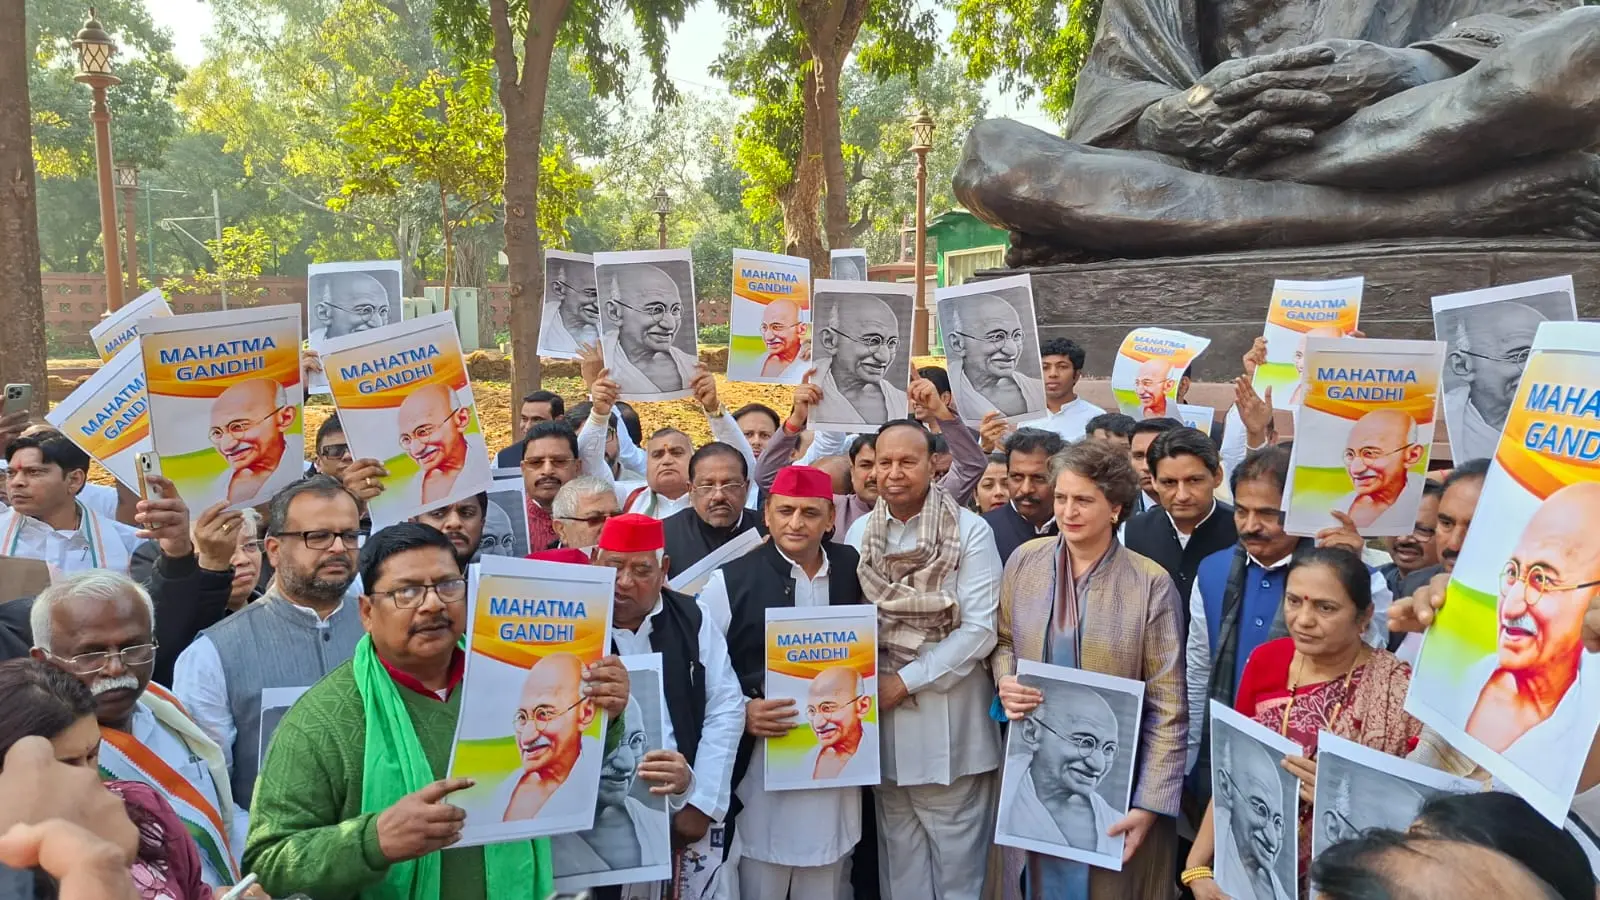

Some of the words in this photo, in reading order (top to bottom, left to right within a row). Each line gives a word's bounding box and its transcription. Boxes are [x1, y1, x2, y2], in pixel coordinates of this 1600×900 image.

[741, 268, 799, 283] MAHATMA
[748, 281, 793, 294] GANDHI
[1280, 298, 1347, 309] MAHATMA
[1286, 311, 1338, 320] GANDHI
[159, 336, 276, 363] MAHATMA
[1134, 336, 1186, 349] MAHATMA
[1134, 344, 1176, 356] GANDHI
[176, 356, 264, 381] GANDHI
[340, 343, 440, 380] MAHATMA
[358, 363, 433, 394] GANDHI
[1317, 367, 1417, 382] MAHATMA
[1327, 386, 1404, 401] GANDHI
[1525, 383, 1600, 418] MAHA
[1525, 421, 1600, 460] GAND
[490, 597, 587, 617] MAHATMA
[500, 623, 574, 641] GANDHI
[777, 630, 857, 646] MAHATMA
[787, 647, 848, 662] GANDHI
